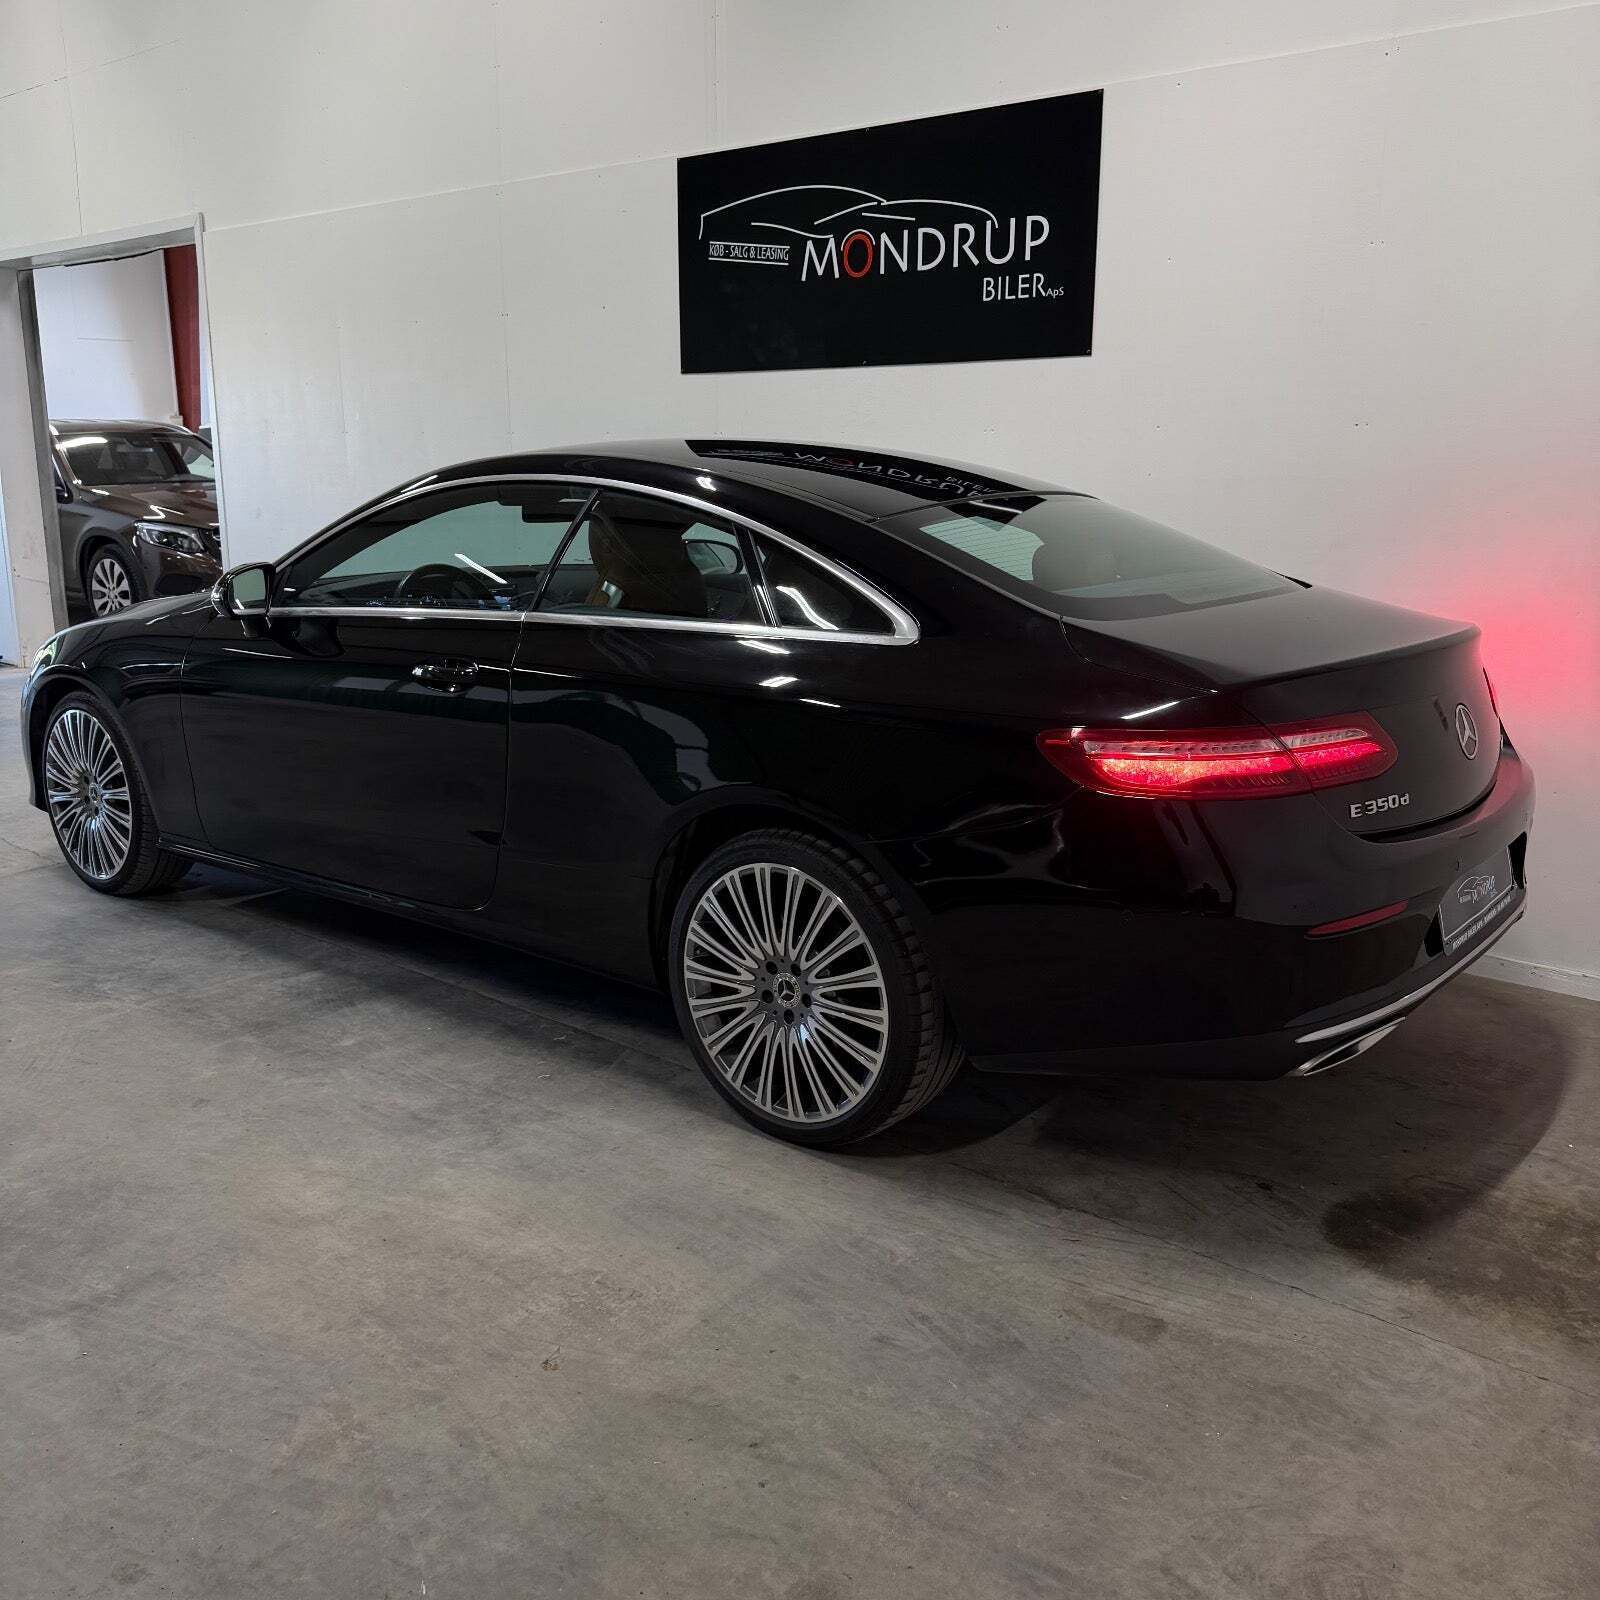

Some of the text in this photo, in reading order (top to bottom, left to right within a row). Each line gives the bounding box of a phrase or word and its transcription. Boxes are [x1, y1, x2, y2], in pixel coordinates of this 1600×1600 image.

[709, 244, 725, 257] KØB
[730, 245, 748, 258] SALG
[750, 246, 755, 259] &
[757, 246, 789, 261] LEASING
[801, 214, 1050, 282] MONDRUP
[983, 272, 1064, 302] BILER ApS
[1350, 803, 1362, 818] E
